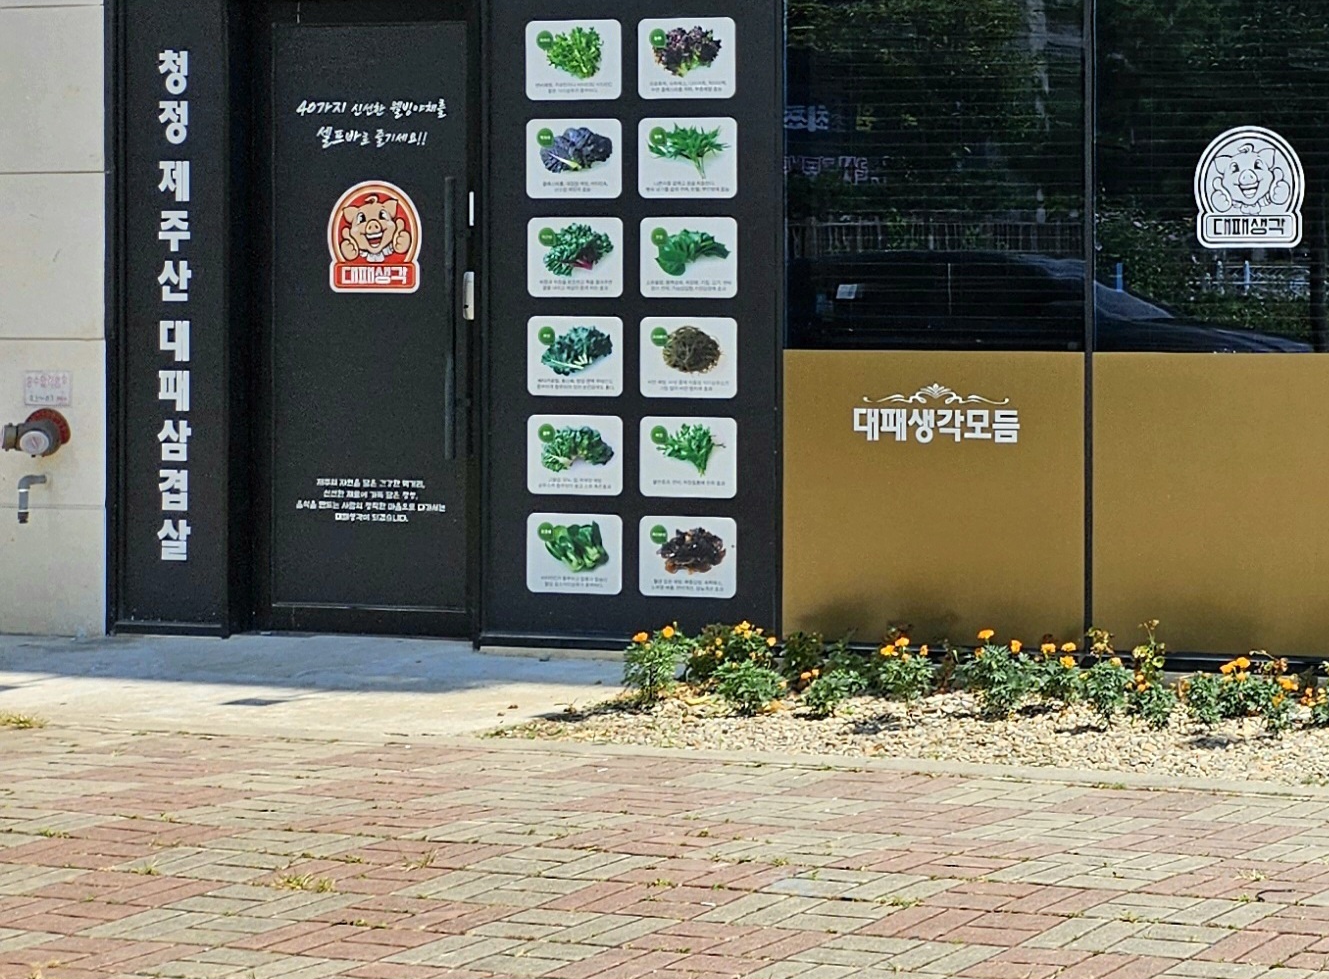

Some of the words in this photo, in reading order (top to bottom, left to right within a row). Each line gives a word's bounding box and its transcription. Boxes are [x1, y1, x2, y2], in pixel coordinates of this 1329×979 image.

[157, 48, 190, 145] 청정
[295, 99, 347, 117] 40가지
[350, 101, 386, 118] 신선한
[316, 126, 371, 149] 셀프바로
[374, 128, 428, 148] 즐기세요!!
[156, 159, 192, 303] 제주산
[1213, 217, 1285, 235] 대패생각
[341, 266, 408, 285] 대패생각
[853, 406, 1021, 444] 대패생각모듬
[156, 319, 192, 562] 대패삼겹살
